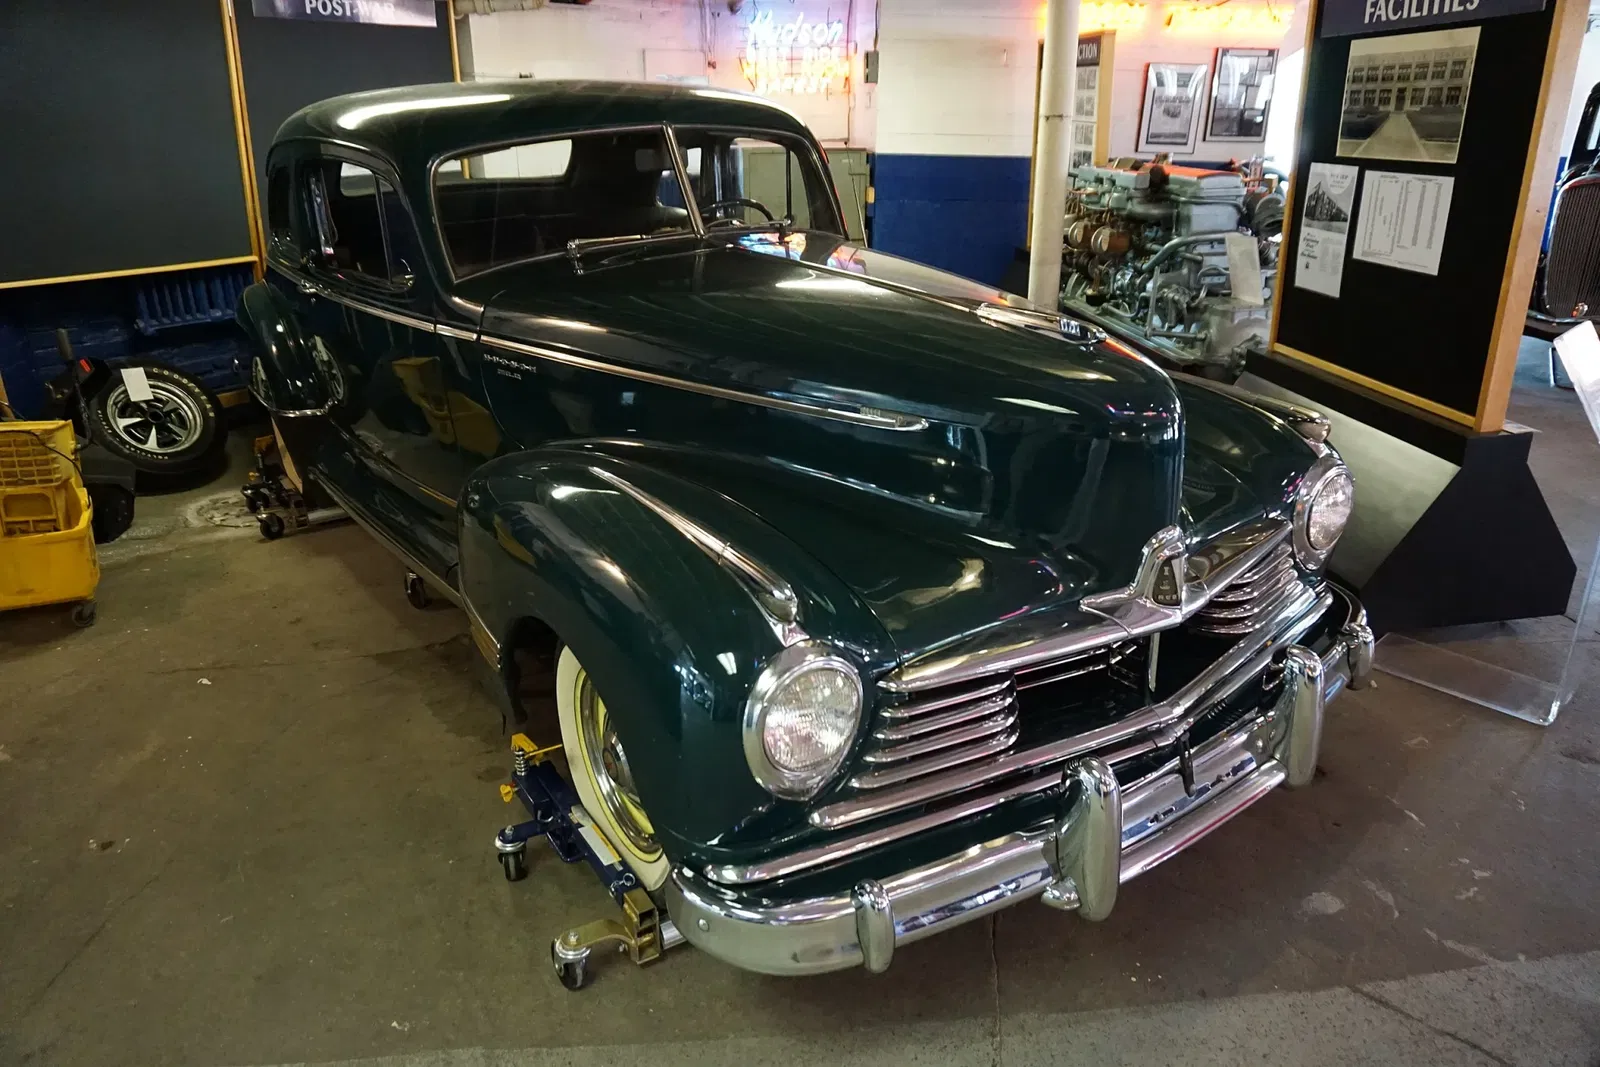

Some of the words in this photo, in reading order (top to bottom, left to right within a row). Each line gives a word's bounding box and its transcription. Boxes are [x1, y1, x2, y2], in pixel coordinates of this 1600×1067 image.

[304, 0, 396, 20] POST-WAR
[1363, 0, 1479, 24] FACILITIES
[1077, 43, 1098, 60] CTION
